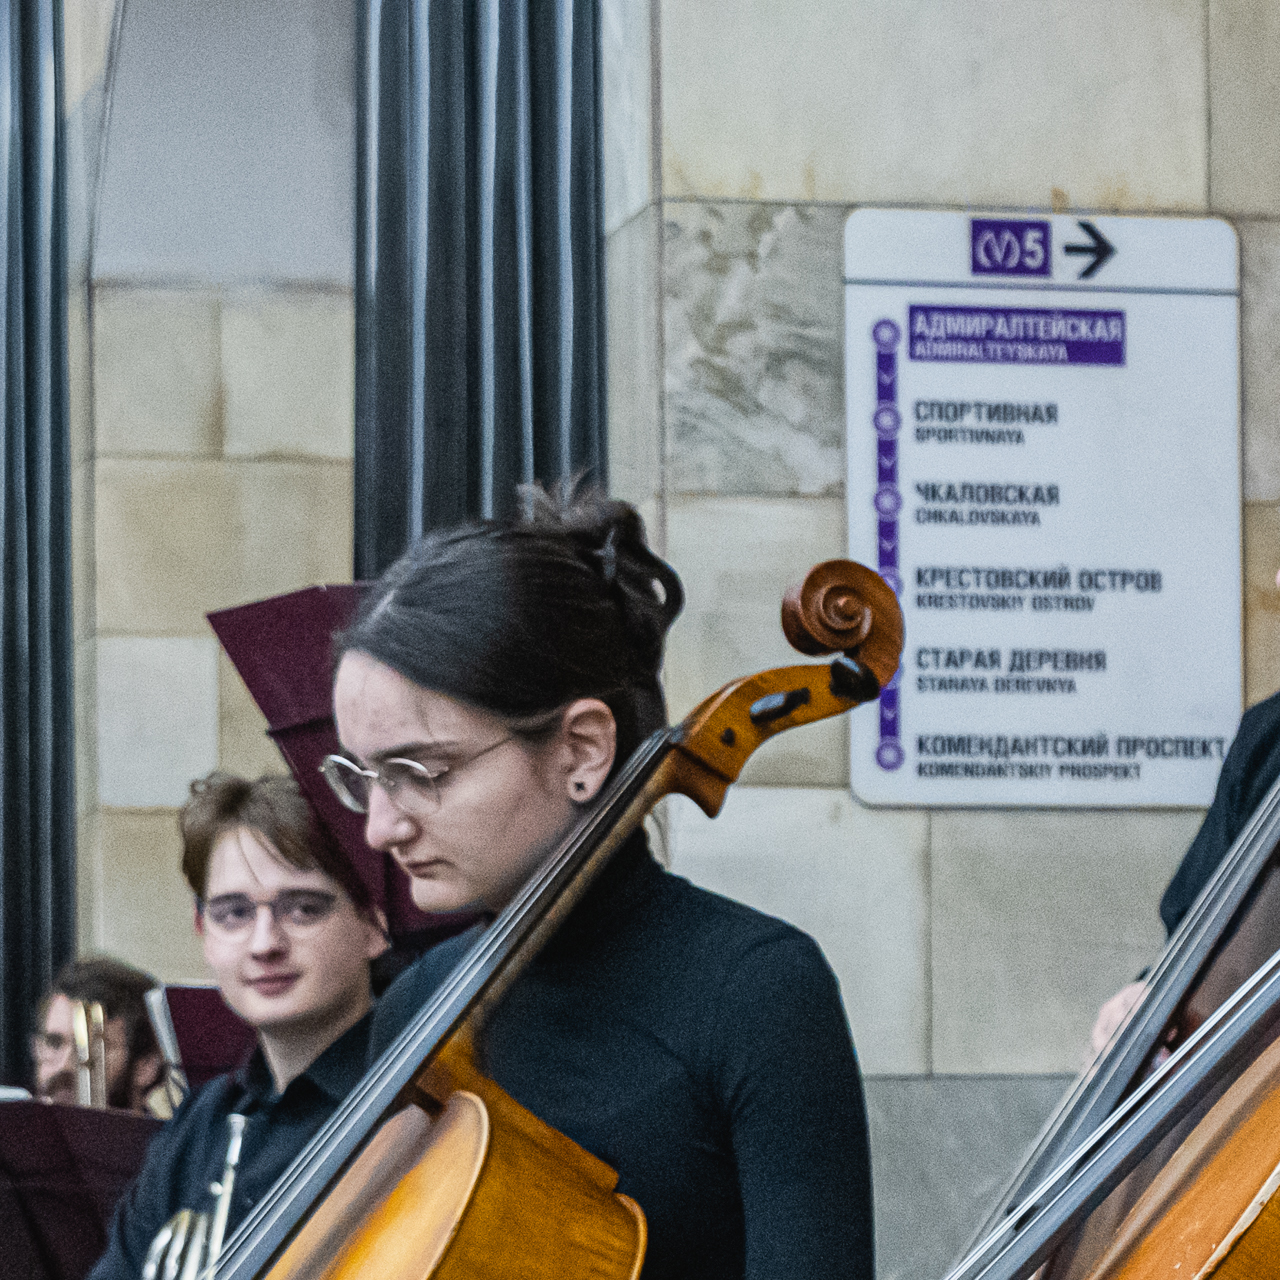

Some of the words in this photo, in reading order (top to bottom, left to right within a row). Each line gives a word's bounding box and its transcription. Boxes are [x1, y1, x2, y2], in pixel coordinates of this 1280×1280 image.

[915, 310, 1122, 342] АДМИРАЛТЕЙСКАЯ
[914, 340, 1069, 361] ADMIRALTEYSKAYA
[915, 401, 1058, 423] СПОРТИВНАЯ
[915, 427, 1025, 444] SPORTIVNAYA
[916, 483, 1060, 505] ЧКАЛОВСКАЯ
[916, 508, 1041, 525] CHKALOVSKAYA
[916, 564, 1071, 590] КРЕСТОВСКИЙ
[1078, 568, 1163, 592] ОСТРОВ
[916, 594, 1024, 611] KRESTOVSKIY
[1031, 595, 1096, 612] OSTROV
[917, 648, 1002, 670] СТАРАЯ
[1008, 650, 1107, 673] ДЕРЕВНЯ
[917, 676, 989, 693] STARAYA
[993, 677, 1077, 694] DEREVNYA
[917, 732, 1109, 760] КОМЕНДАНТСКИЙ
[917, 762, 1052, 779] KOMENDANTSKIY
[1059, 763, 1142, 780] PROSPEKT
